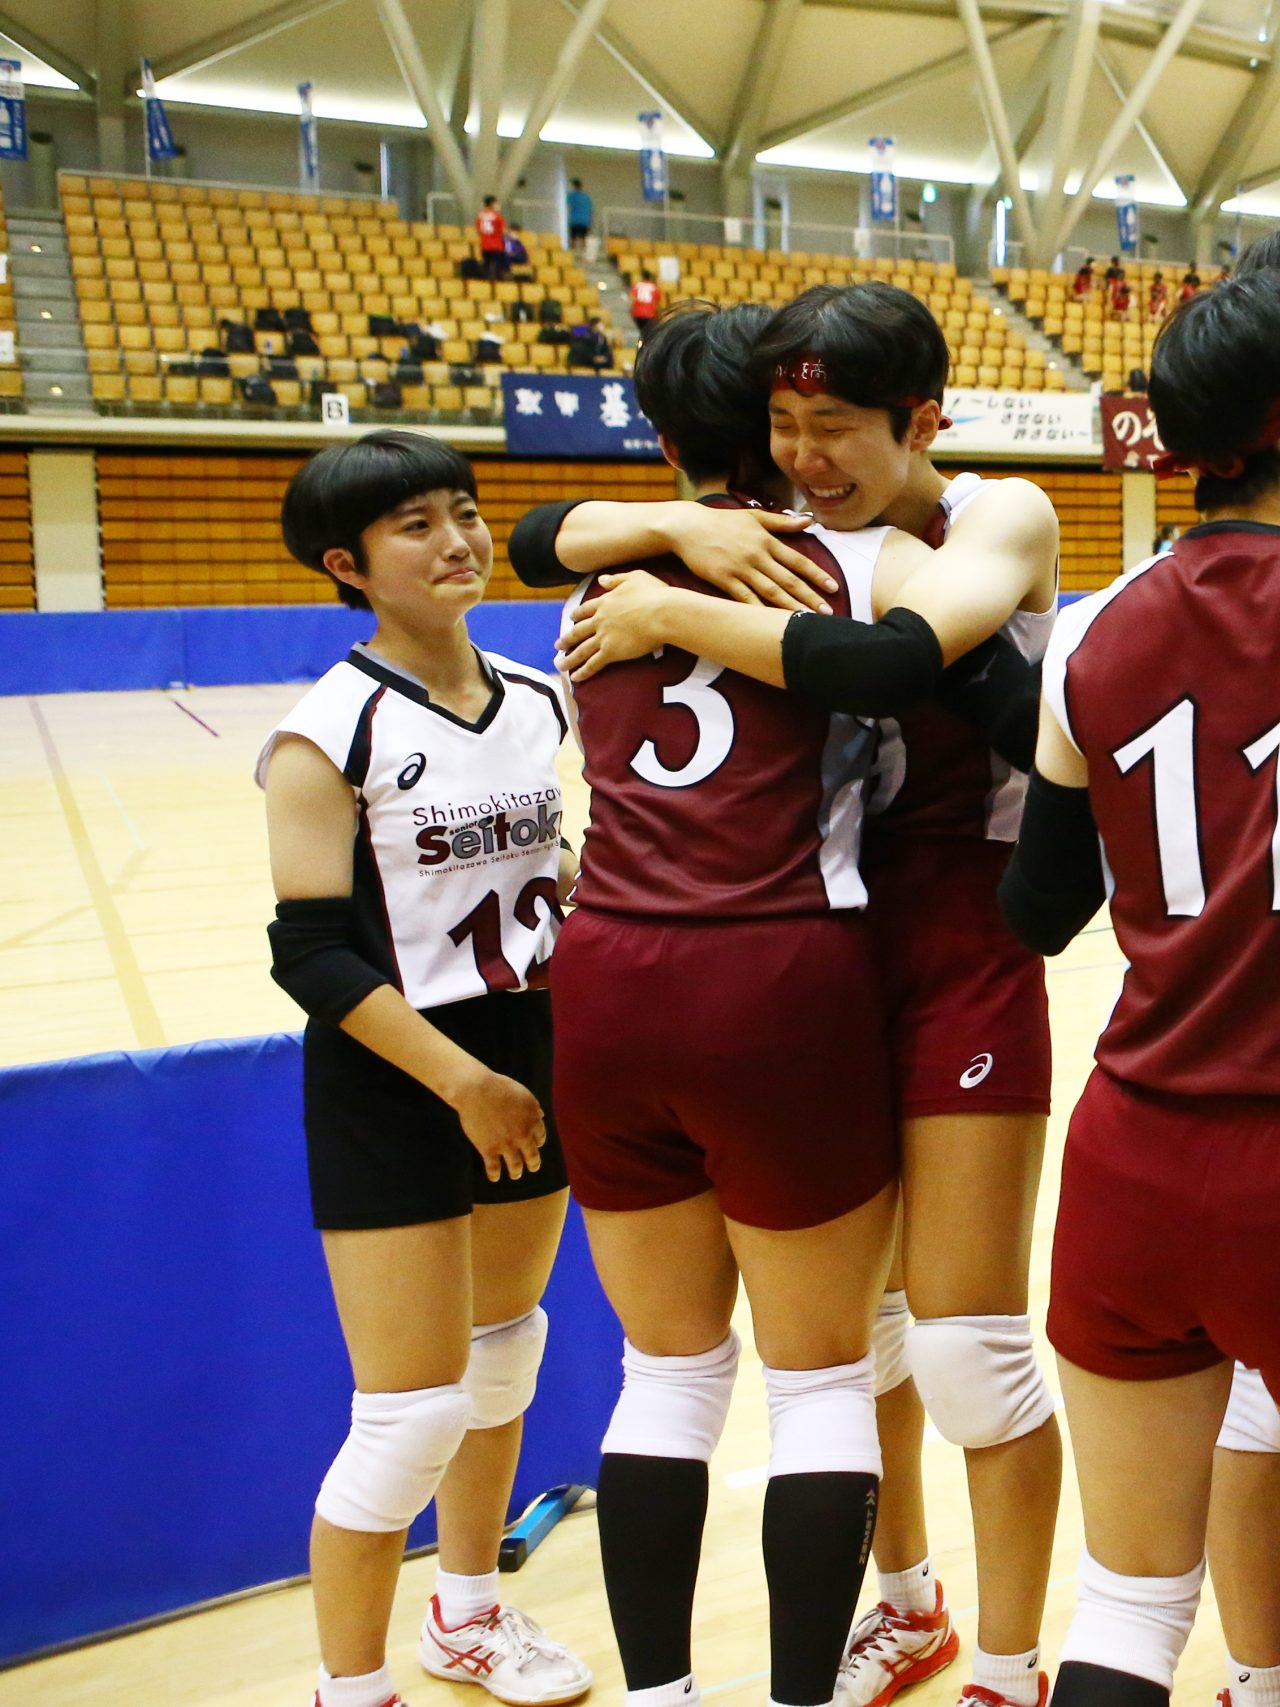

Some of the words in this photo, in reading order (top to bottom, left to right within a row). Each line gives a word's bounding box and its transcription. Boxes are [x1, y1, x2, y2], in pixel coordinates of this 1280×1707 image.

[327, 400, 343, 419] B
[629, 645, 735, 789] 3
[415, 803, 563, 866] Seitok
